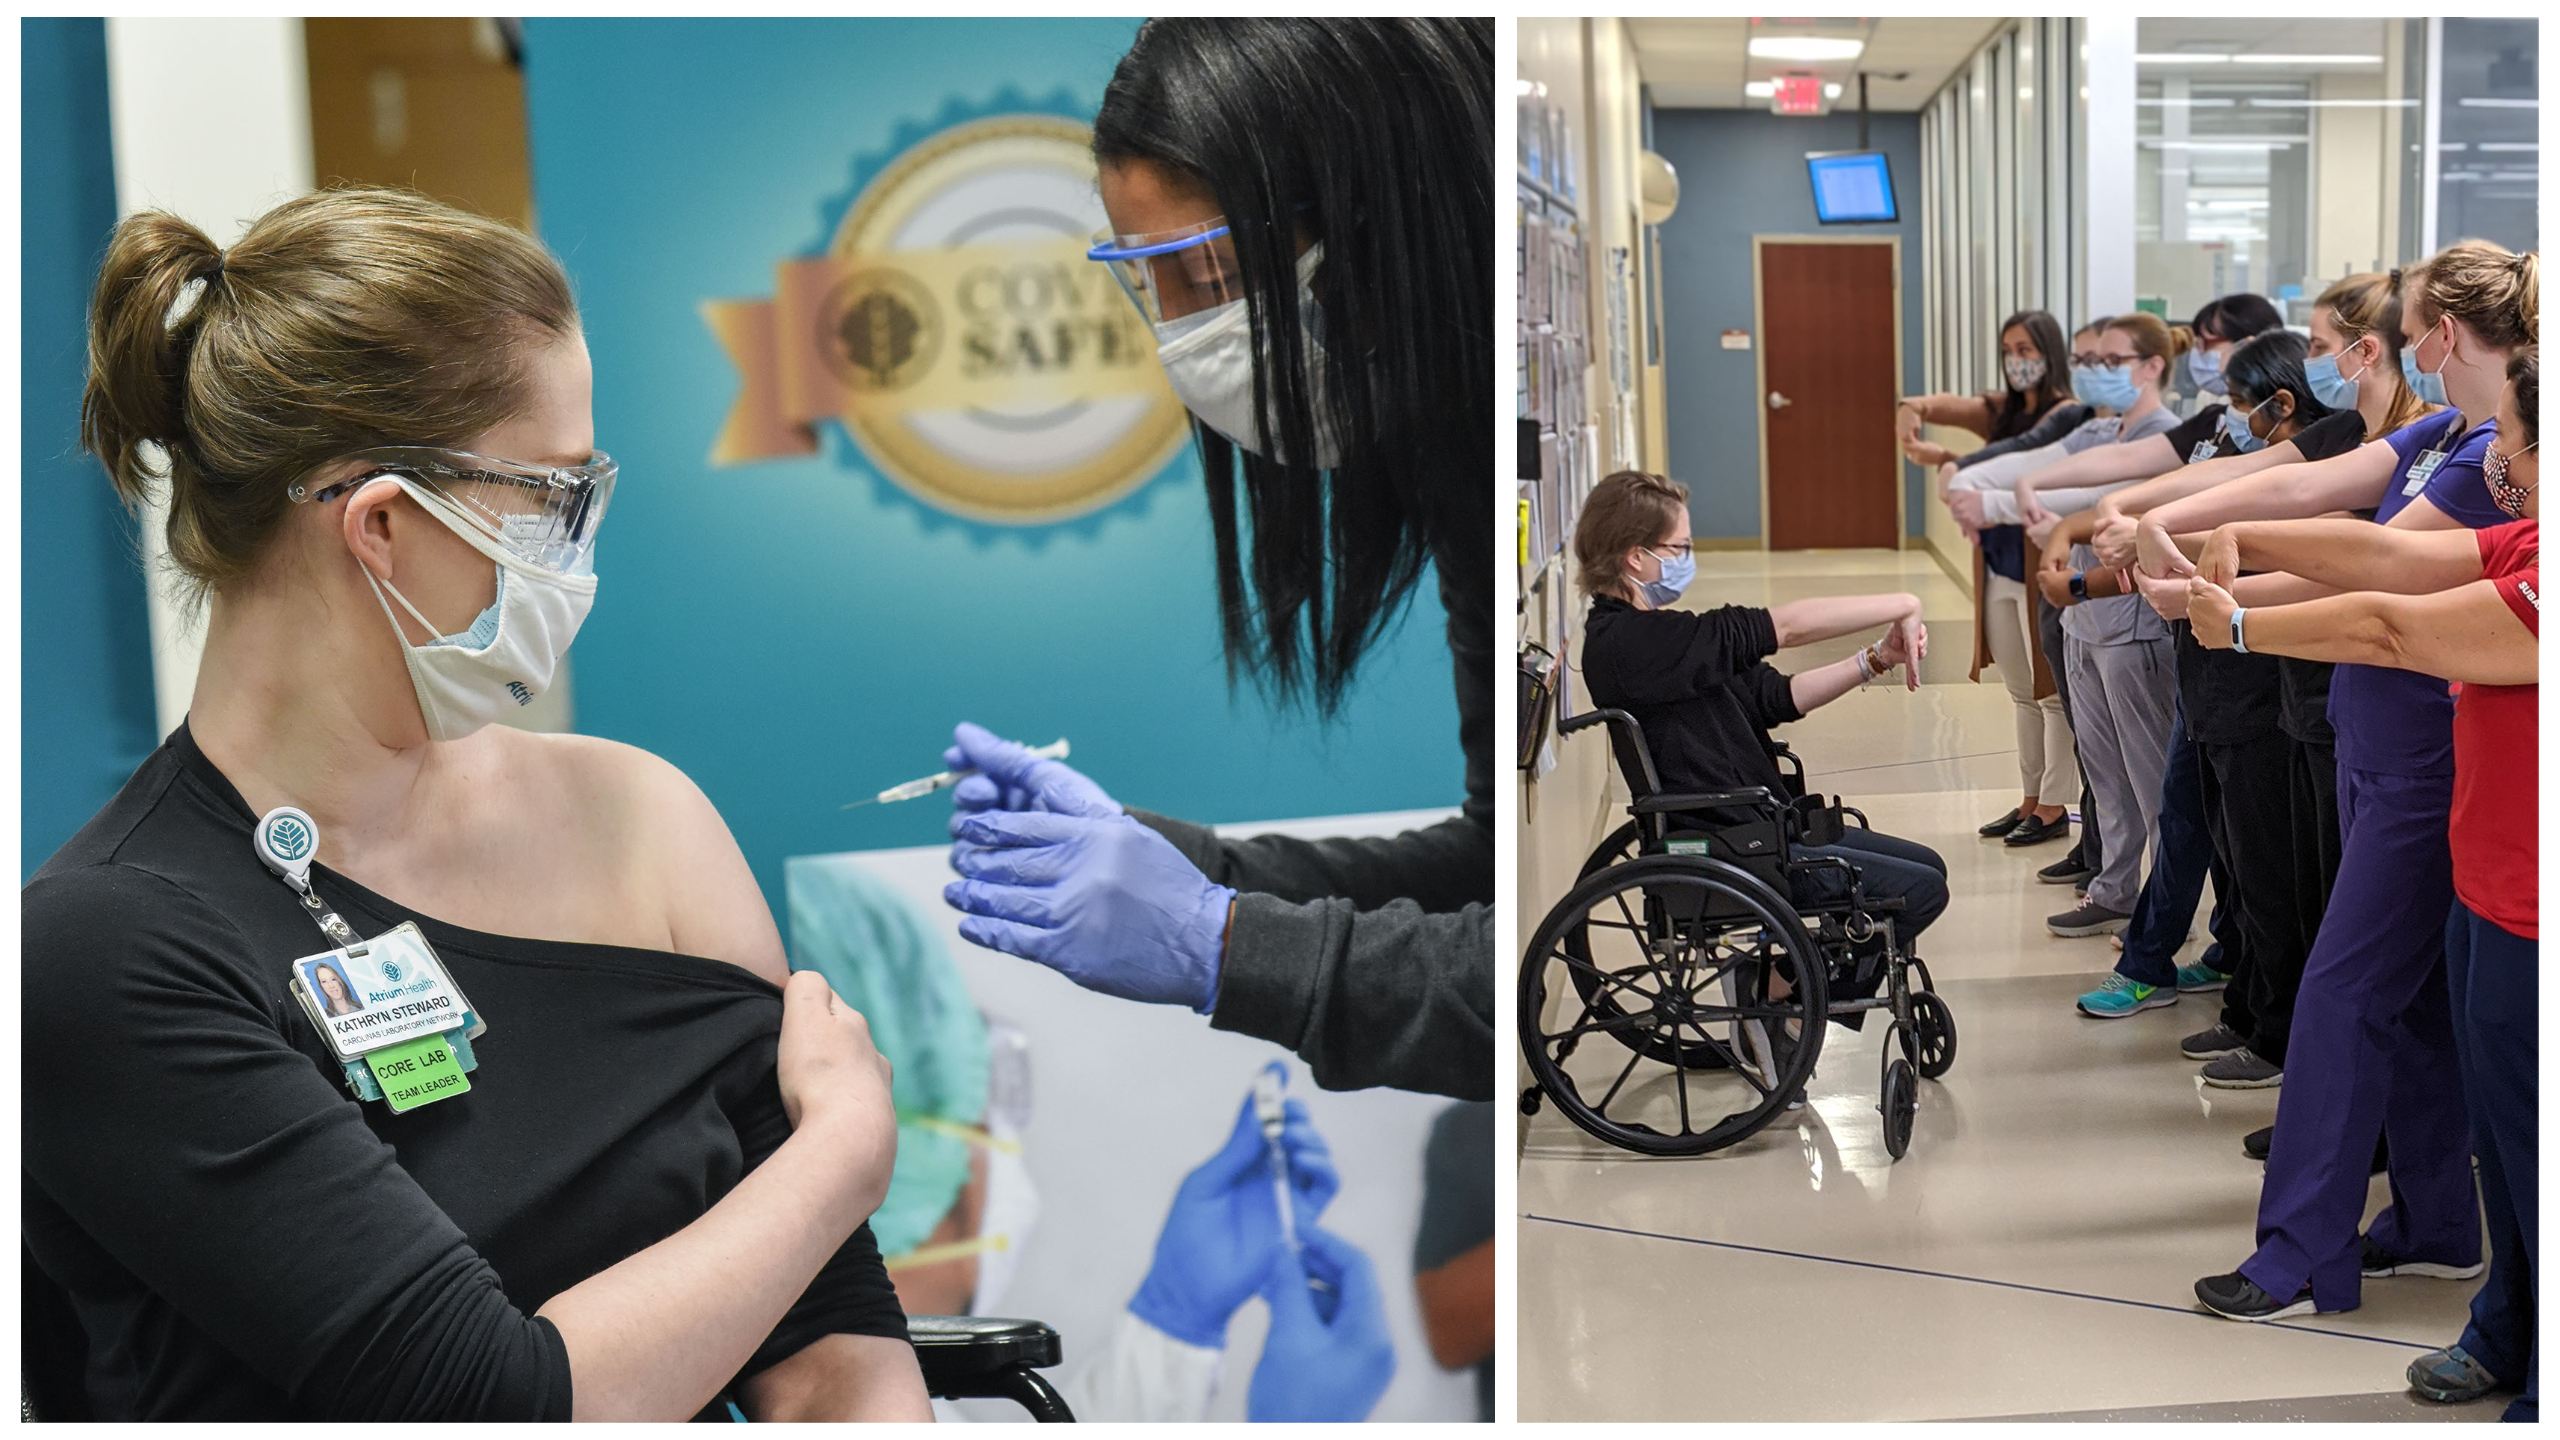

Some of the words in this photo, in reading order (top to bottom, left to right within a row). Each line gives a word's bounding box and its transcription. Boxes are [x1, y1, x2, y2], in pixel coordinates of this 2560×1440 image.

[960, 312, 1146, 380] SAFE
[369, 987, 406, 1004] Atrium
[404, 978, 438, 995] Health
[333, 1010, 392, 1034] KATHRYN
[392, 995, 450, 1020] STEWARD
[342, 1031, 382, 1046] CAROLINAS
[382, 1020, 425, 1037] LABORATORY
[425, 1011, 460, 1026] NETWORK
[378, 1059, 416, 1079] CORE
[419, 1050, 447, 1067] LAB
[392, 1086, 420, 1101] TEAM
[420, 1074, 460, 1093] LEADER
